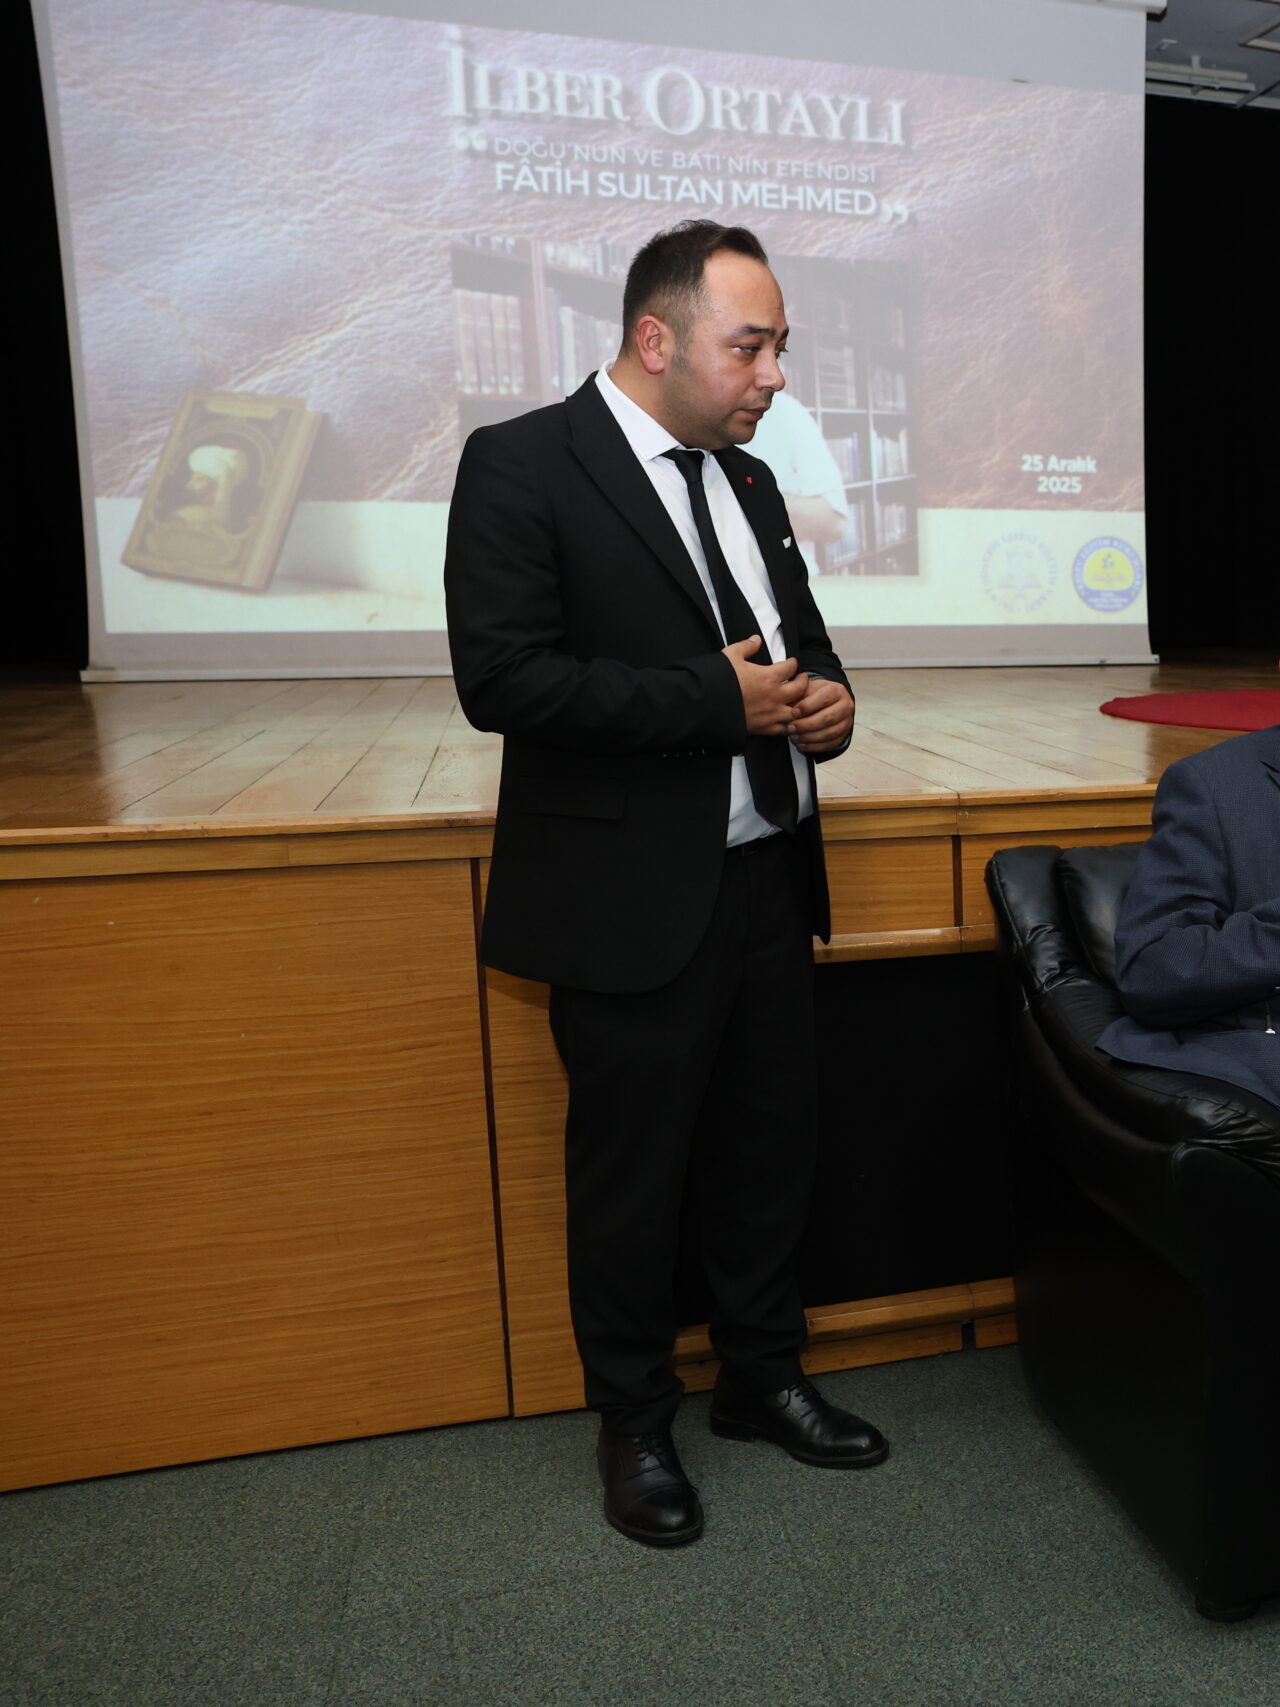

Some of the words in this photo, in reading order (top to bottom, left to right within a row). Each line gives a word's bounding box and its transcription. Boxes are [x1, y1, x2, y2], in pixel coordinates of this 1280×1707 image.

[645, 66, 907, 145] ORTAYLI
[633, 148, 664, 168] VE
[495, 157, 590, 196] FÂTİH
[597, 171, 724, 206] SULTAN
[1020, 454, 1044, 472] 25
[1046, 454, 1097, 473] Aralık
[1036, 476, 1083, 494] 2025
